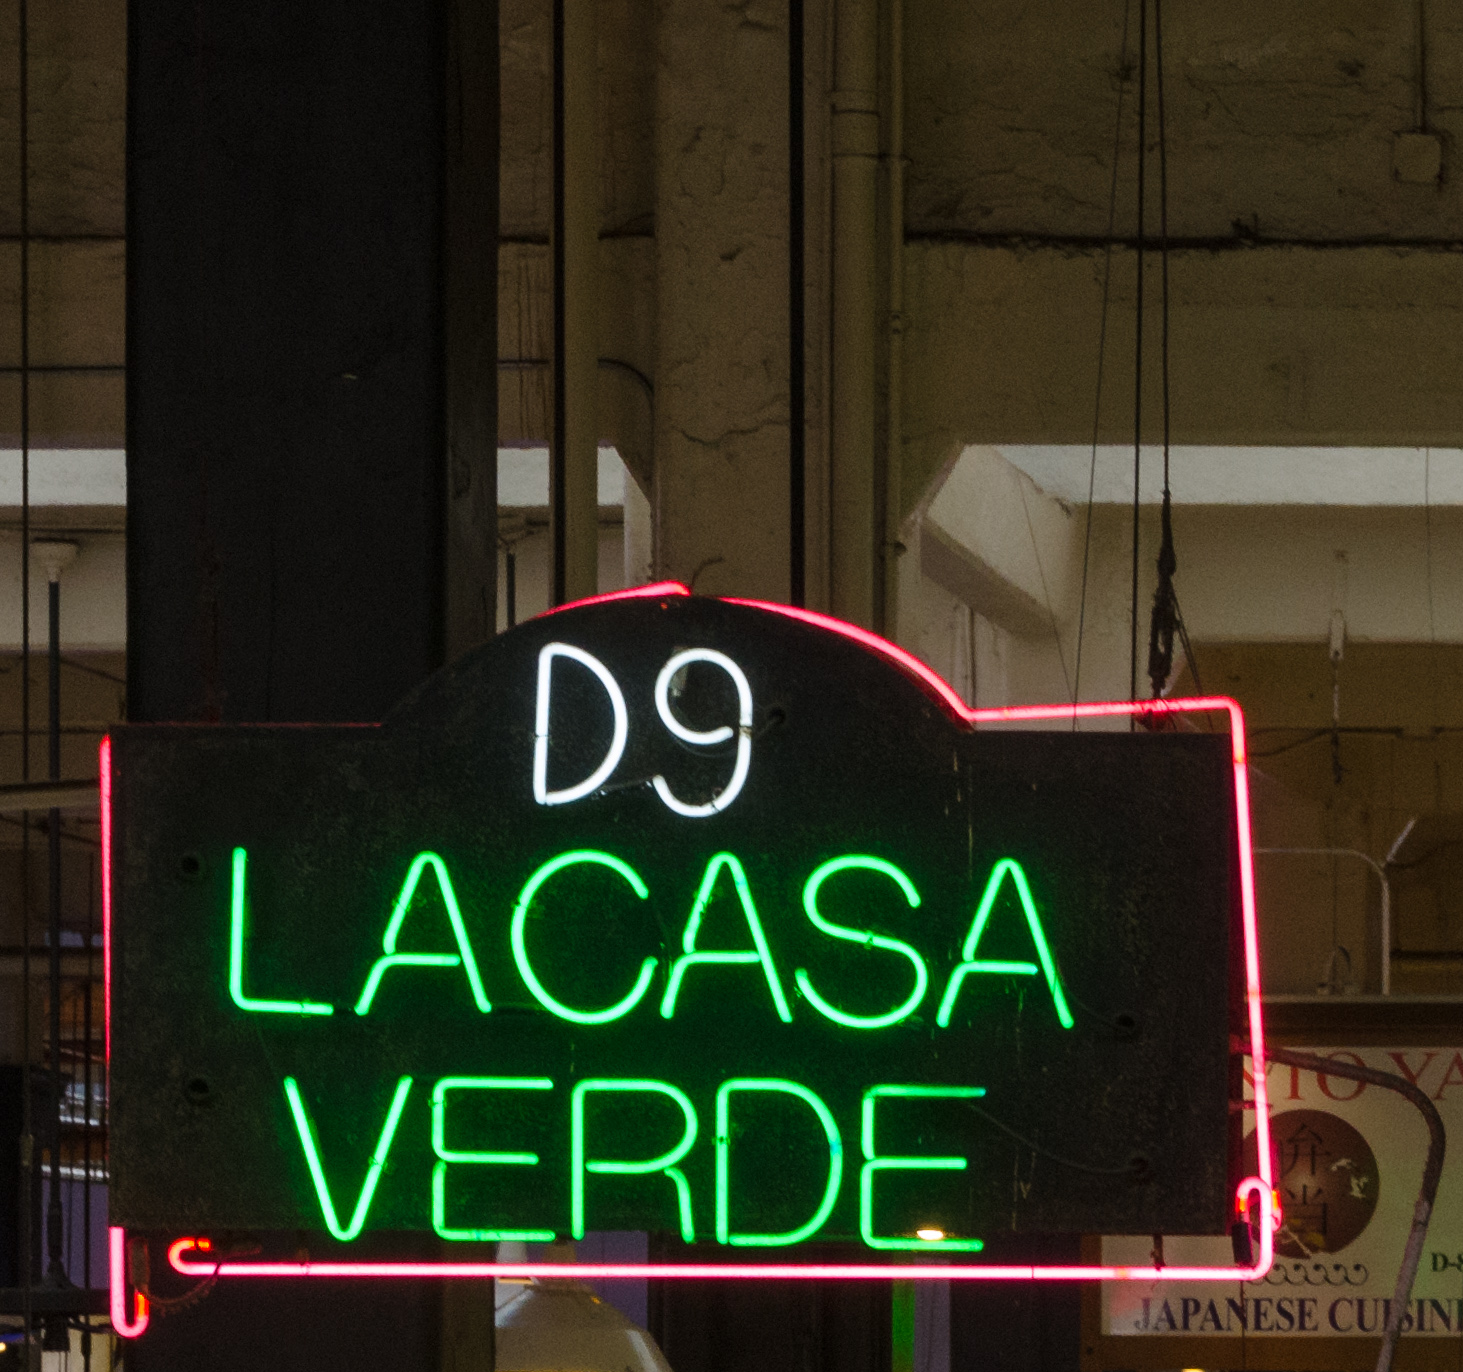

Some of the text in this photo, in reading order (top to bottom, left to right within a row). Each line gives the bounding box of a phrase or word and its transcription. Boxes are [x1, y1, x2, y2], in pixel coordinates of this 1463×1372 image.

[533, 640, 754, 819] D9
[281, 1074, 988, 1253] VERDE
[1133, 1297, 1319, 1333] JAPANESE
